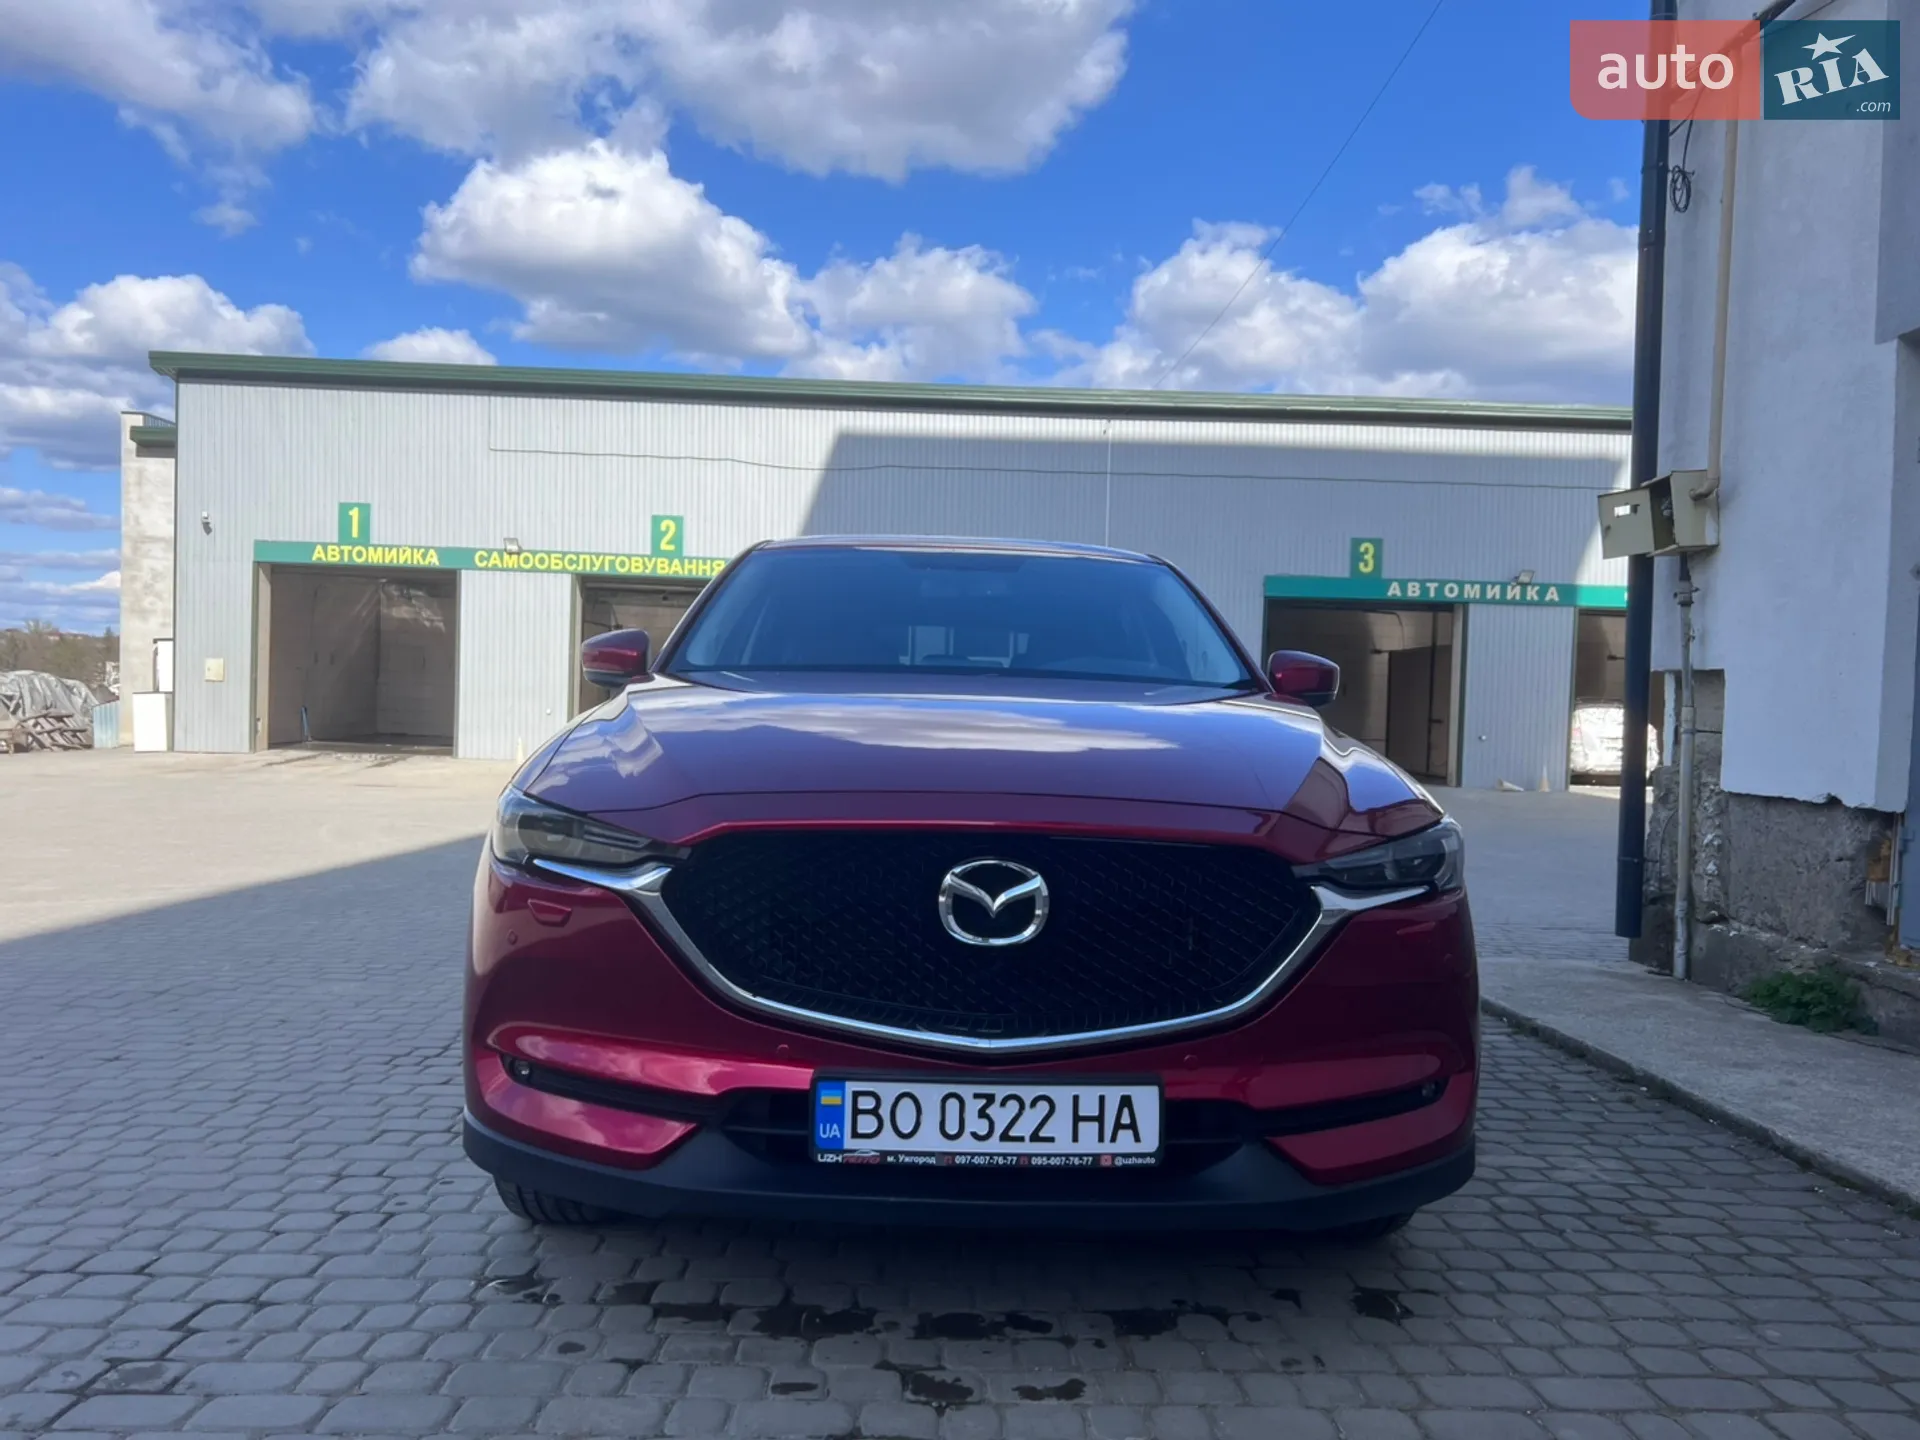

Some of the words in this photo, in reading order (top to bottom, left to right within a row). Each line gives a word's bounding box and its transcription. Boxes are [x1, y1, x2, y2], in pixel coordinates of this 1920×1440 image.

[348, 507, 360, 538] 1
[659, 519, 676, 551] 2
[312, 544, 440, 566] АВТОМИЙКА
[474, 550, 725, 577] САМООБСЛУГОВУВАННЯ
[1358, 542, 1375, 573] 3
[1387, 581, 1560, 602] АВТОМИЙКА
[820, 1123, 841, 1139] UA
[851, 1090, 923, 1139] BO
[939, 1092, 1056, 1143] 0322
[1071, 1094, 1142, 1143] HA
